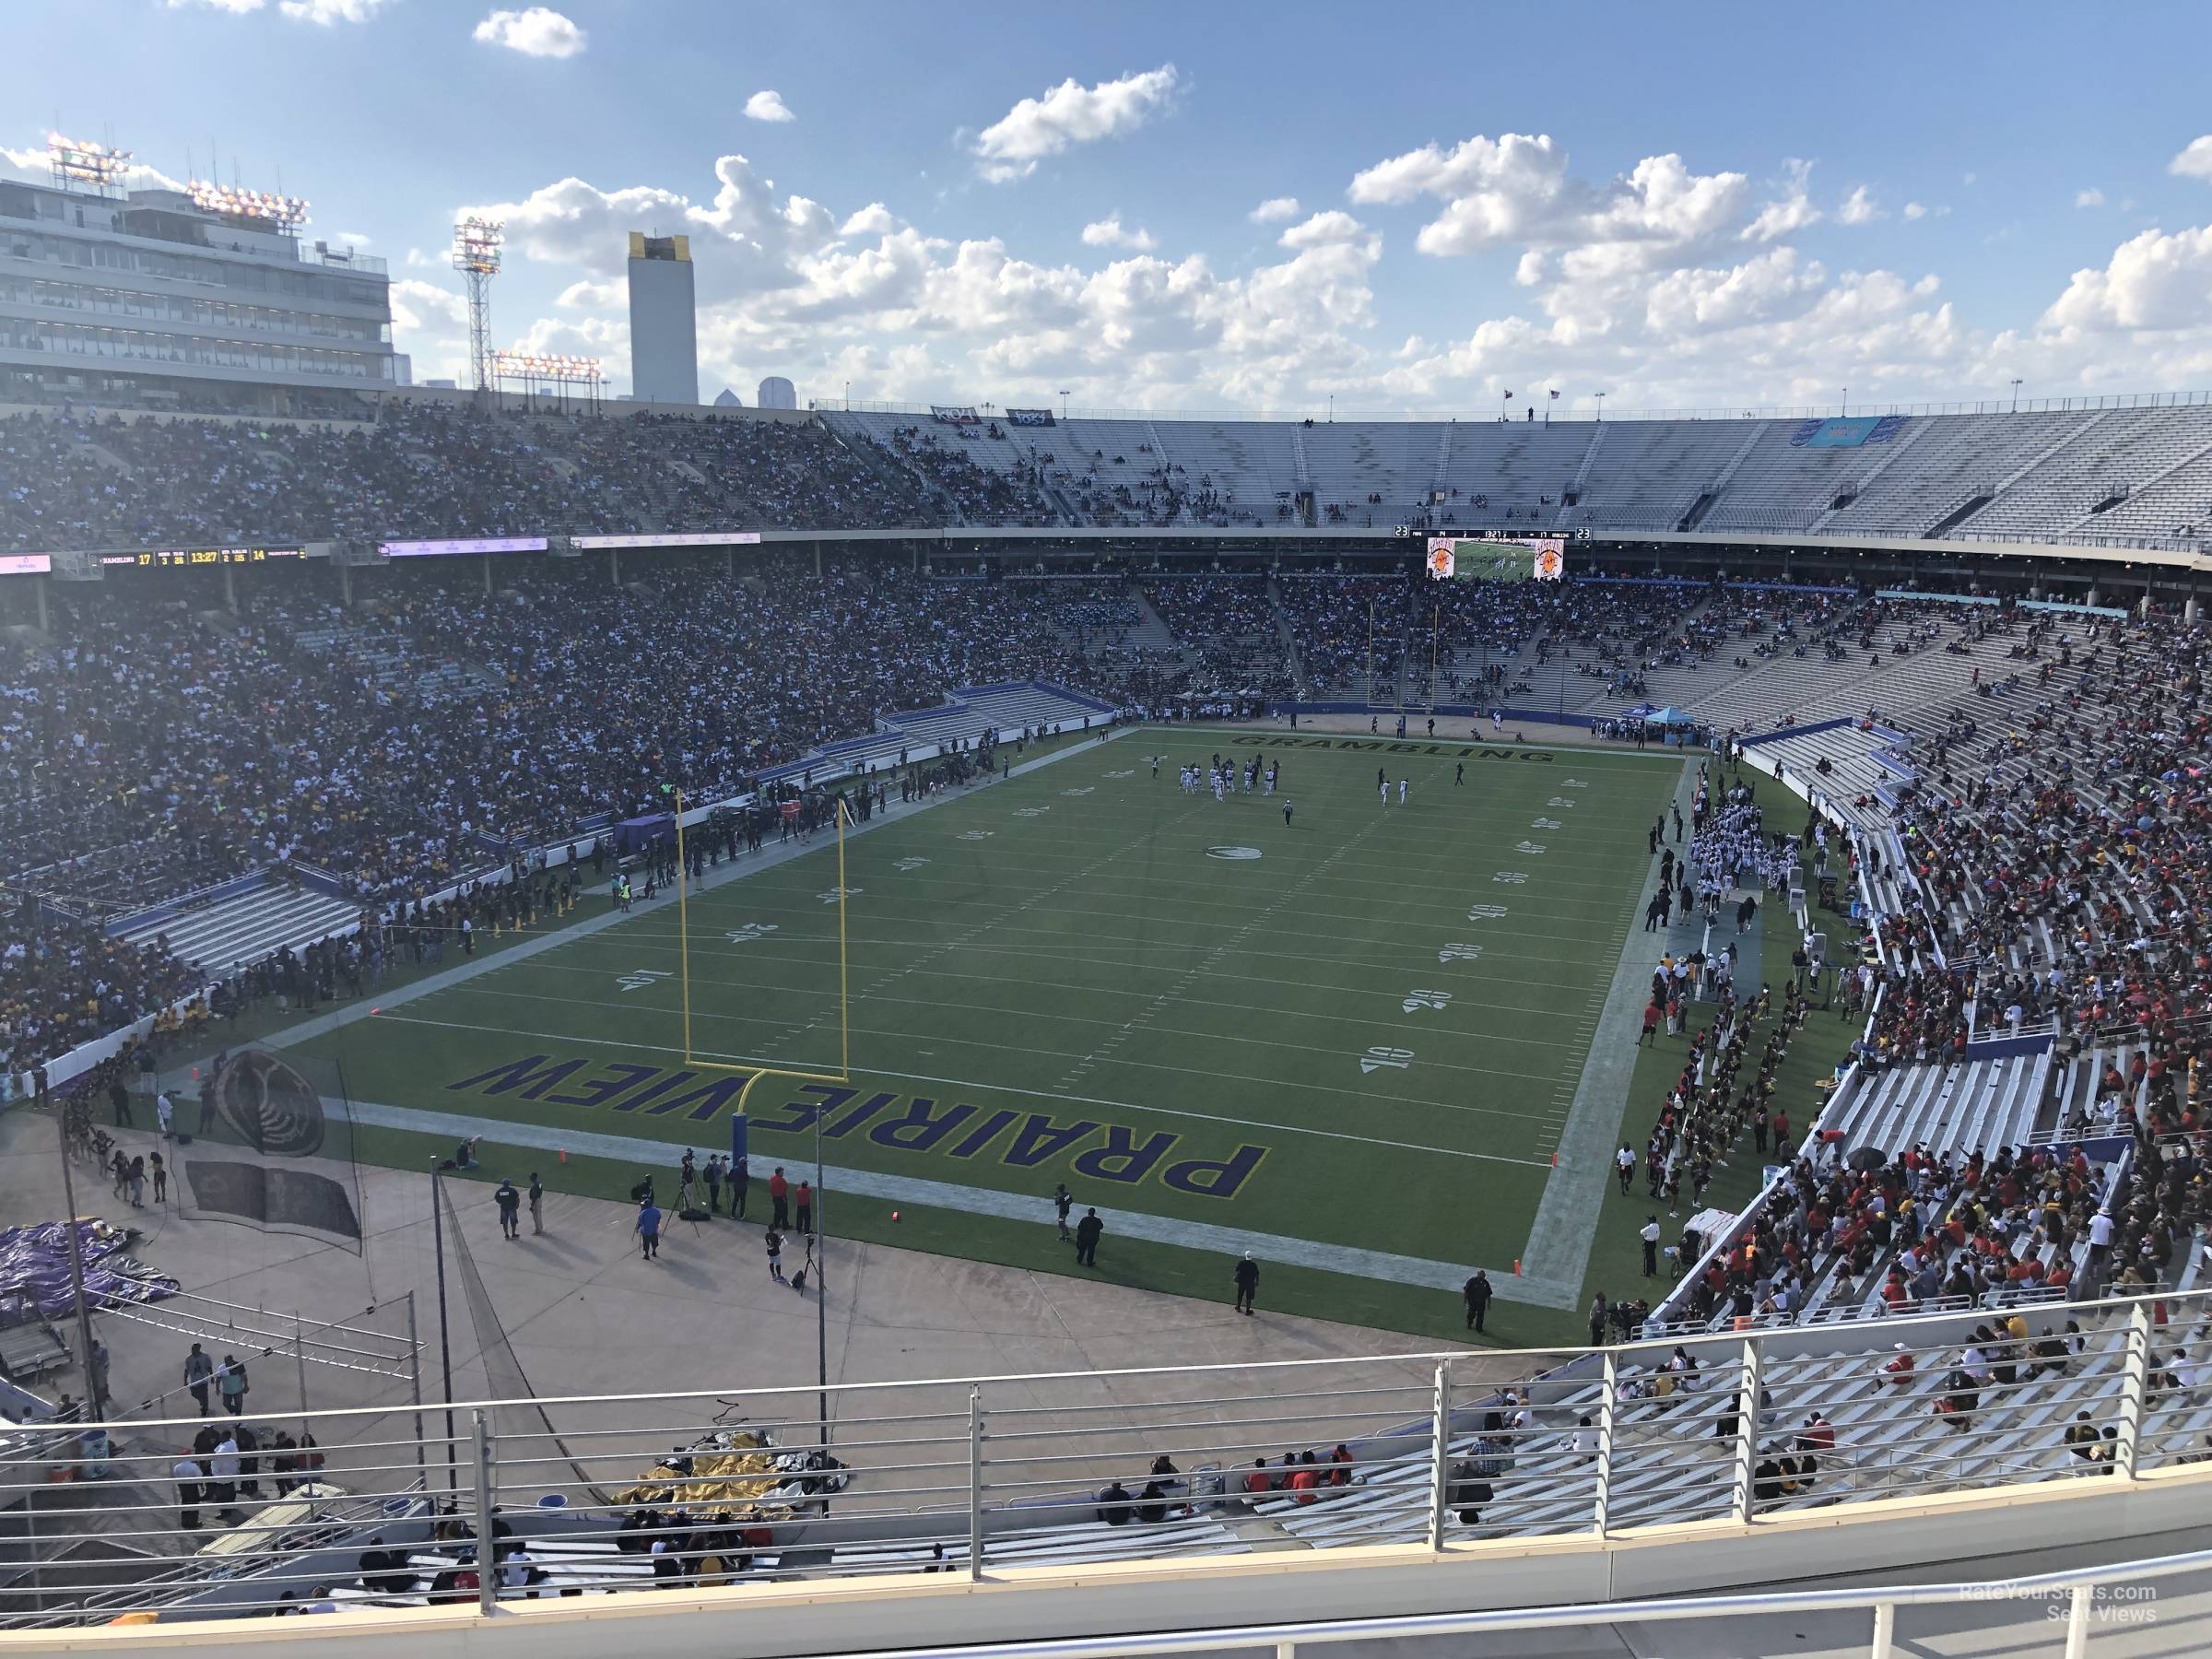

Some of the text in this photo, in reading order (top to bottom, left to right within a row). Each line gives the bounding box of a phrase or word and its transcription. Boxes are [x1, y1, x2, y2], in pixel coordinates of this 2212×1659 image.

[1395, 526, 1408, 536] 23
[1577, 528, 1590, 538] 23
[138, 554, 151, 565] 17
[191, 552, 218, 563] 13:27
[253, 550, 265, 560] 14
[1232, 736, 1555, 763] GRAMBLING
[956, 830, 995, 840] 50
[1513, 842, 1547, 854] 40
[891, 856, 932, 868] 40
[1491, 871, 1529, 884] 50
[1467, 904, 1508, 919] 40
[725, 923, 779, 941] 20
[1439, 943, 1482, 960] 30
[616, 969, 675, 989] 10
[1402, 989, 1453, 1011] 20
[1360, 1046, 1416, 1070] 10
[446, 1053, 1273, 1202] PRAIRIE VIEW
